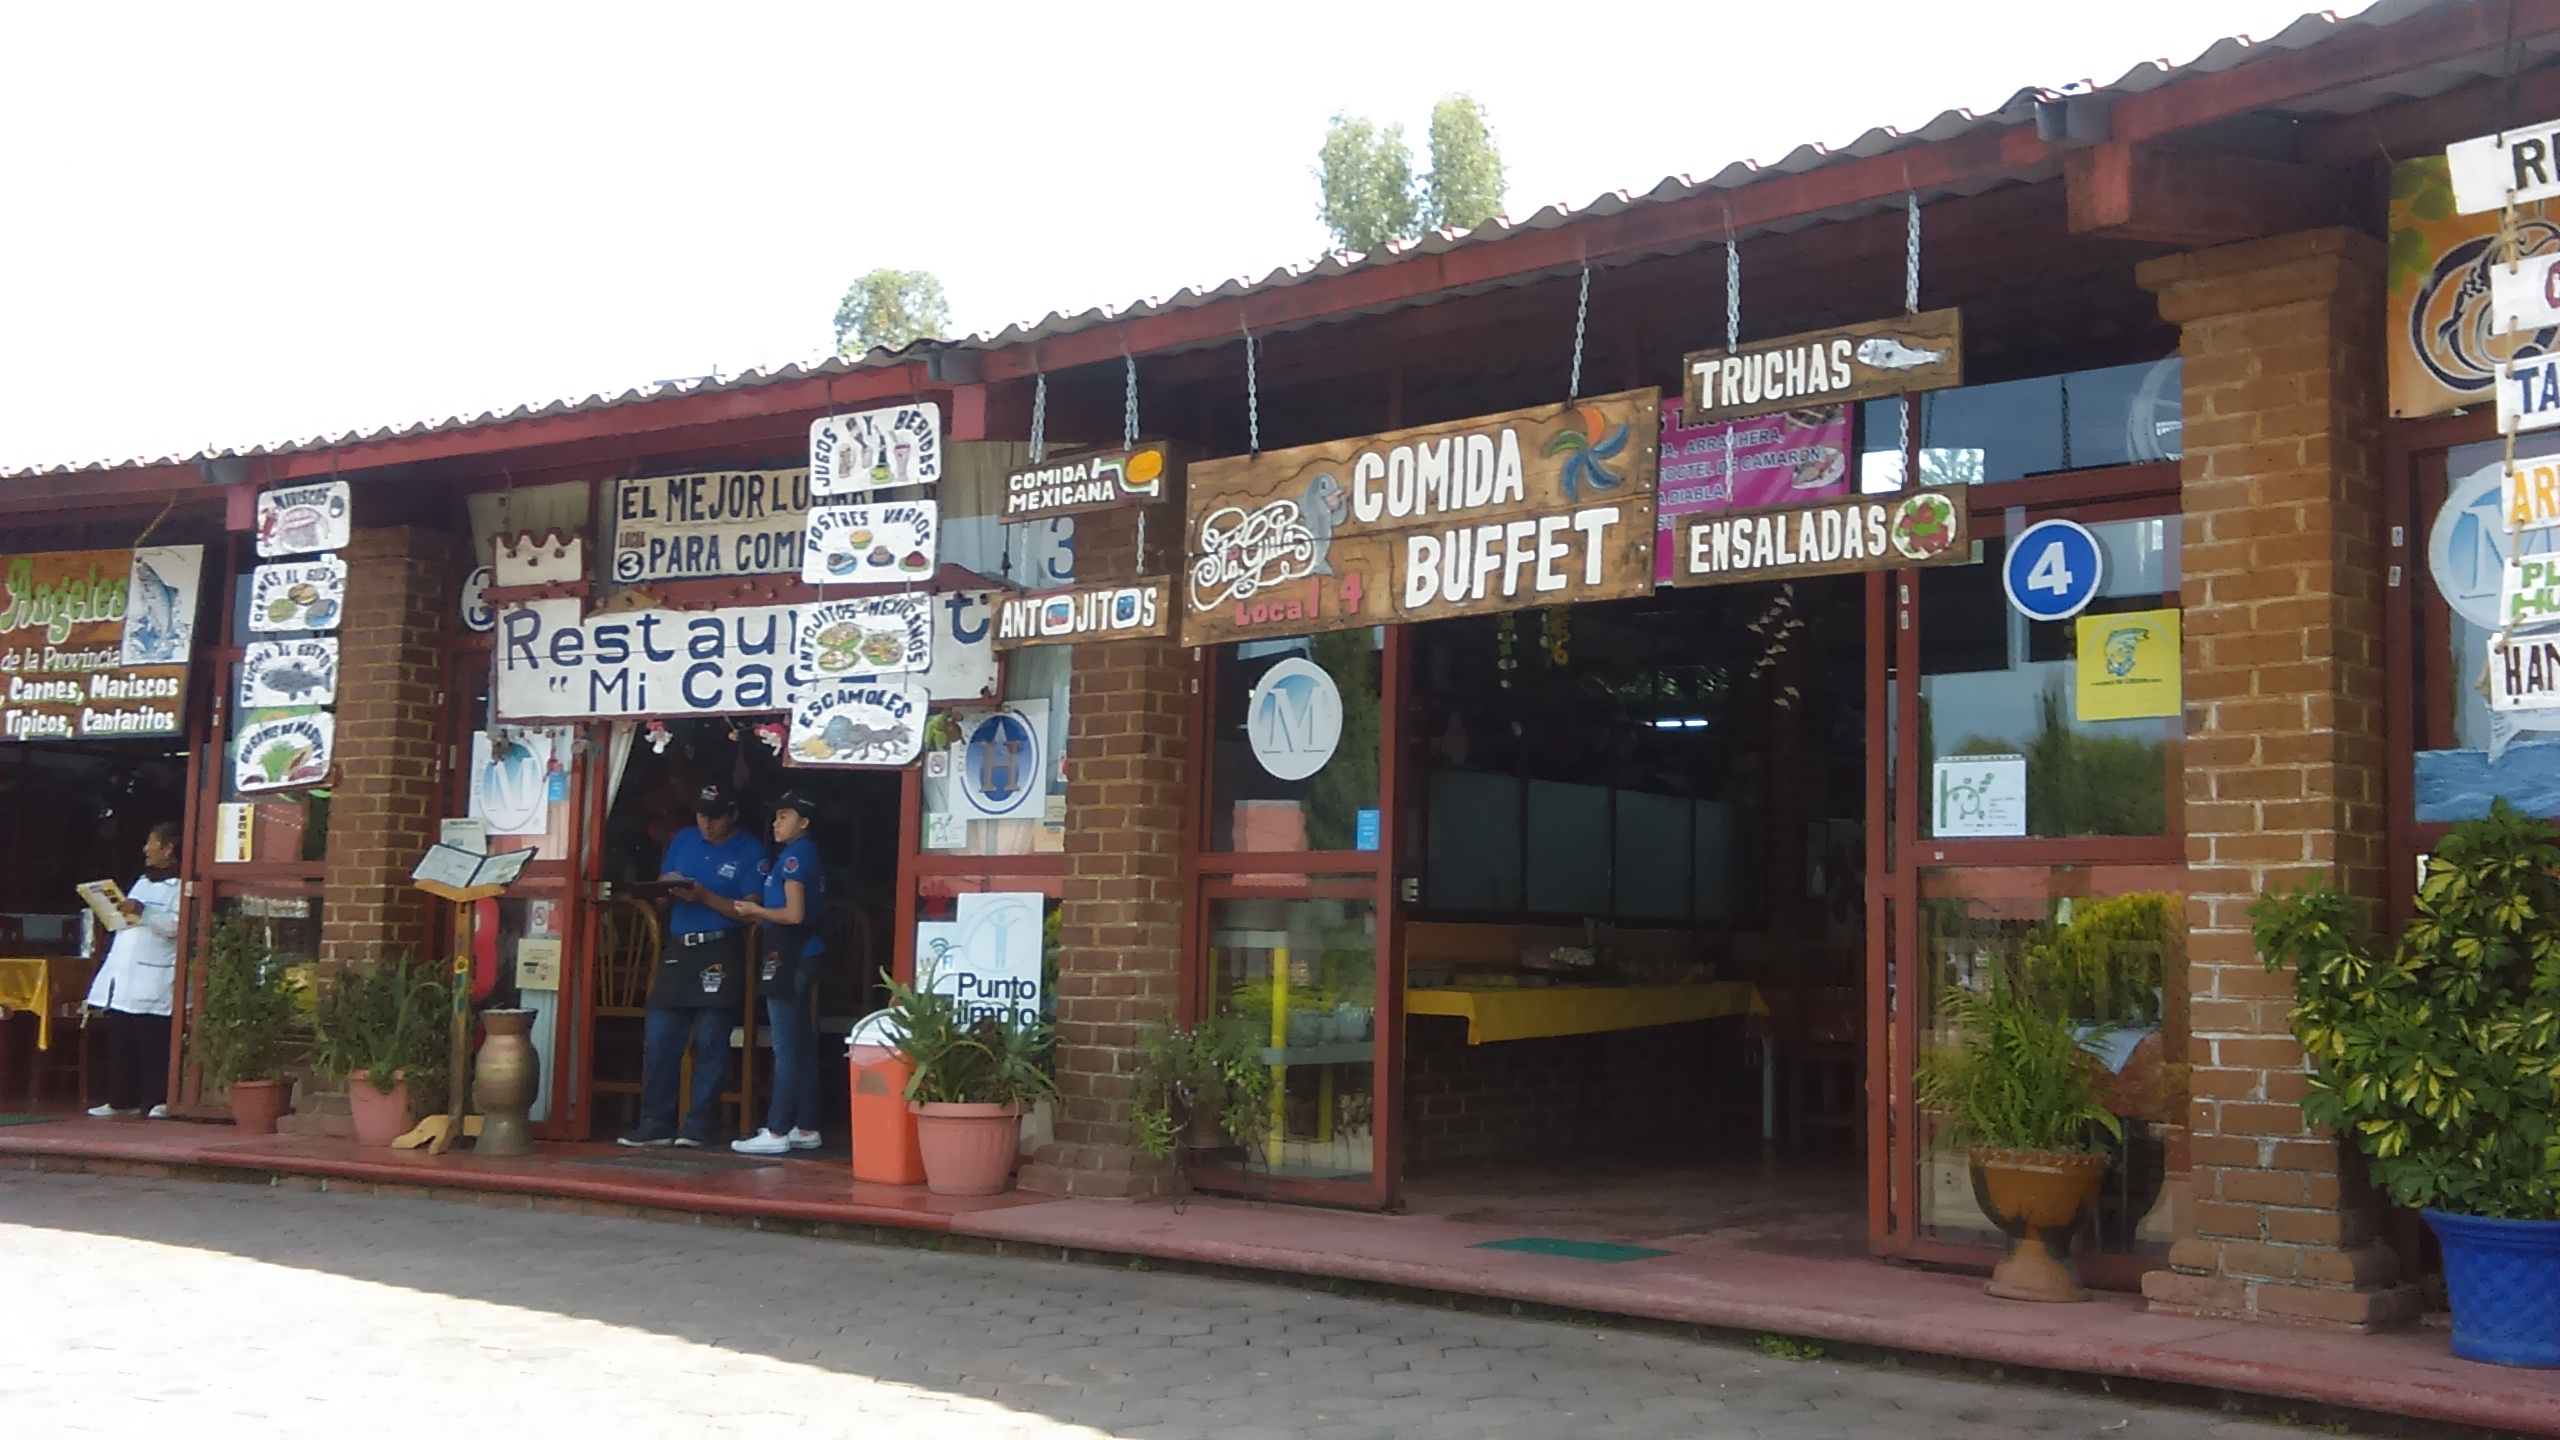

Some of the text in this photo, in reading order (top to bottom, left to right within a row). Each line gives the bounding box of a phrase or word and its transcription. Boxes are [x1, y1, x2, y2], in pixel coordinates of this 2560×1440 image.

[1693, 340, 1851, 409] TRUCHAS
[815, 410, 936, 487] JUGOS Y BEBIDAS
[622, 487, 657, 520] EL
[666, 474, 765, 523] MEJOR
[1008, 479, 1115, 514] MEXICANA
[1009, 464, 1087, 491] COMIDA
[1353, 429, 1523, 521] COMIDA
[2510, 466, 2560, 524] AR
[808, 508, 930, 552] POSTRES VARIOS
[1690, 505, 1886, 573] ENSALADAS
[618, 551, 644, 580] 3
[651, 537, 721, 574] PARA
[1405, 507, 1619, 608] BUFFET
[2027, 541, 2073, 596] 4
[999, 587, 1158, 638] ANTOJITOS
[1340, 572, 1363, 614] 4
[503, 597, 991, 670] Restaut
[800, 603, 857, 672] ANTOJITOS
[1, 647, 122, 672] de la Provincia
[10, 676, 84, 704] Carnes,
[90, 673, 179, 699] Mariscos
[799, 689, 912, 728] ESCAMOLES
[82, 706, 175, 732] Cantaritos
[1262, 687, 1328, 753] M
[957, 971, 1037, 999] Punto
